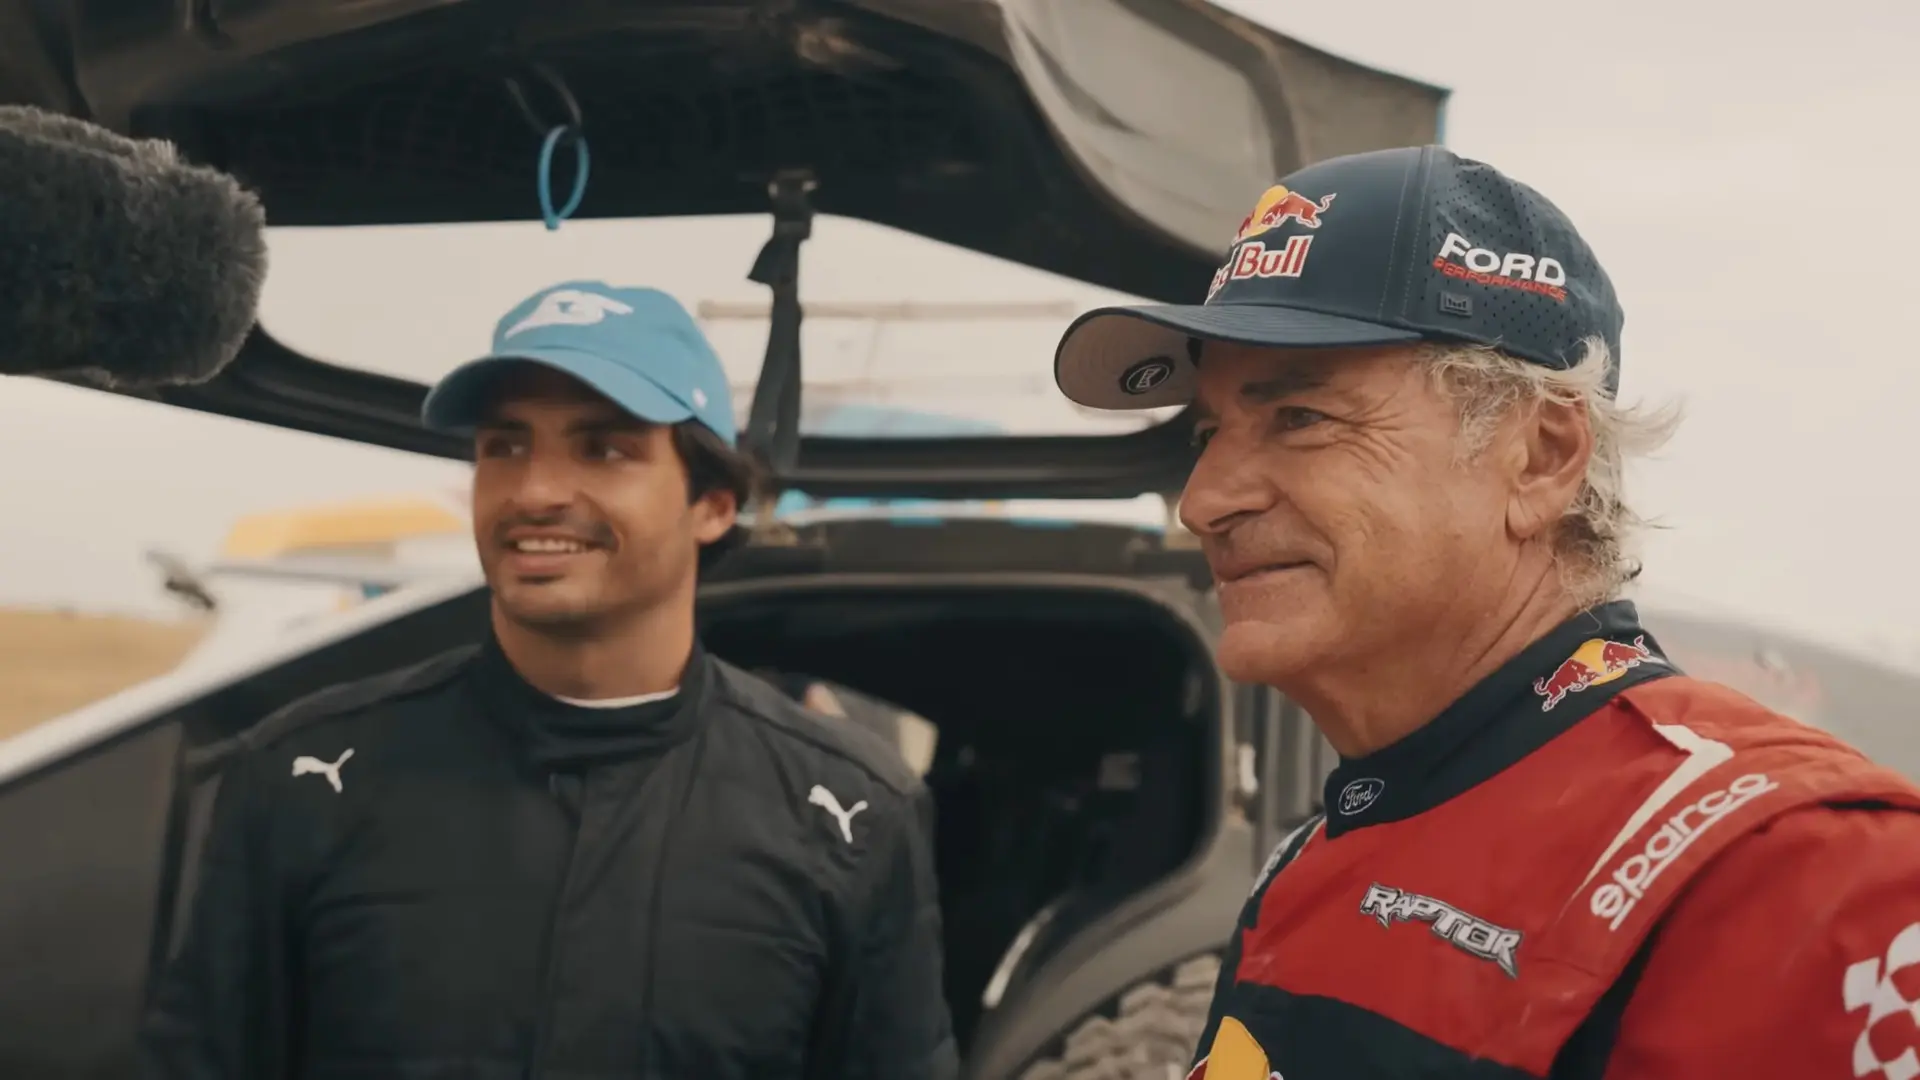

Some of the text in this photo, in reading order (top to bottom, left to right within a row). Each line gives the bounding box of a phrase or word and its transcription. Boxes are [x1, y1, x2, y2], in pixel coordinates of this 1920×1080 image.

[1231, 235, 1314, 279] Bull
[1432, 256, 1568, 303] PERFORMANCE
[1438, 232, 1566, 286] FORD
[1345, 784, 1374, 810] Ford
[1360, 882, 1524, 979] RAPTOR
